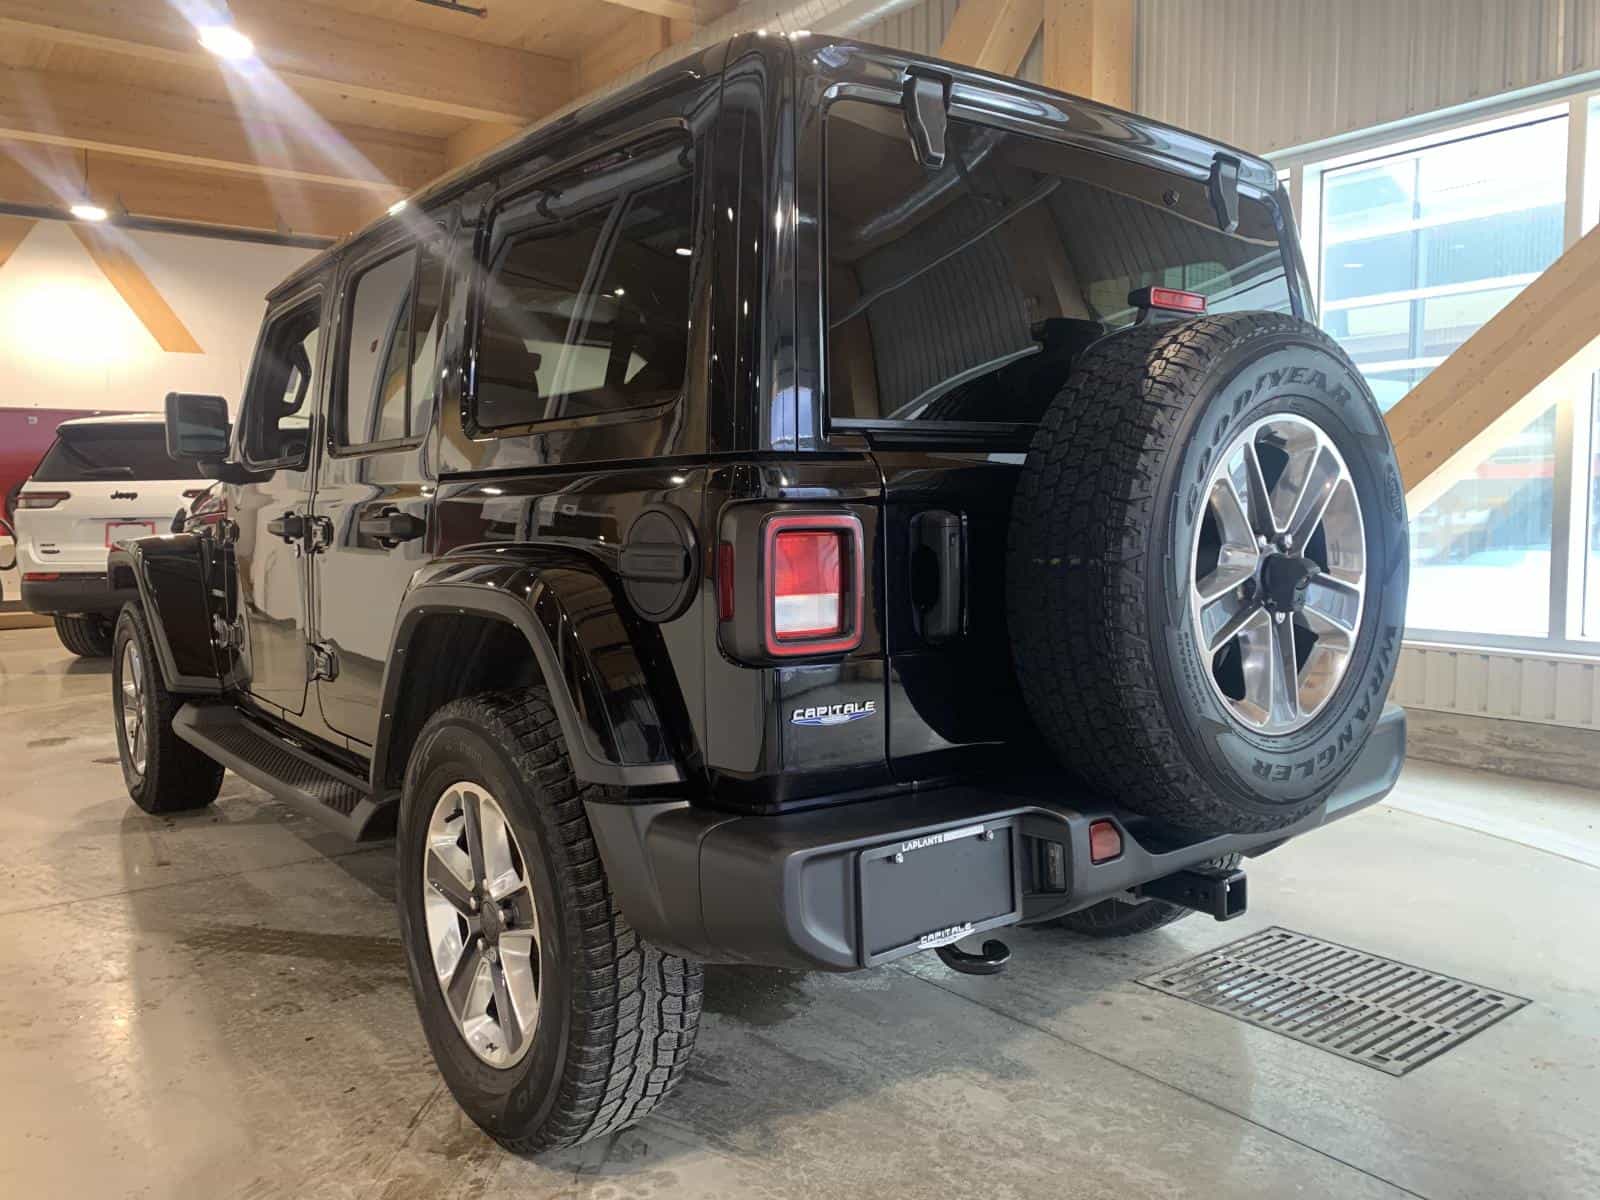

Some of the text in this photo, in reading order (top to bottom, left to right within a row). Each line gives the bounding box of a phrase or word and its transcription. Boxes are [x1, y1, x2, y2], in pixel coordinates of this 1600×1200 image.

[1185, 367, 1351, 526] GOODYEAR
[110, 490, 138, 501] Jeep
[792, 700, 876, 721] CAPITALE
[1252, 626, 1397, 782] WRANGLER
[902, 834, 944, 852] LAPLANTE
